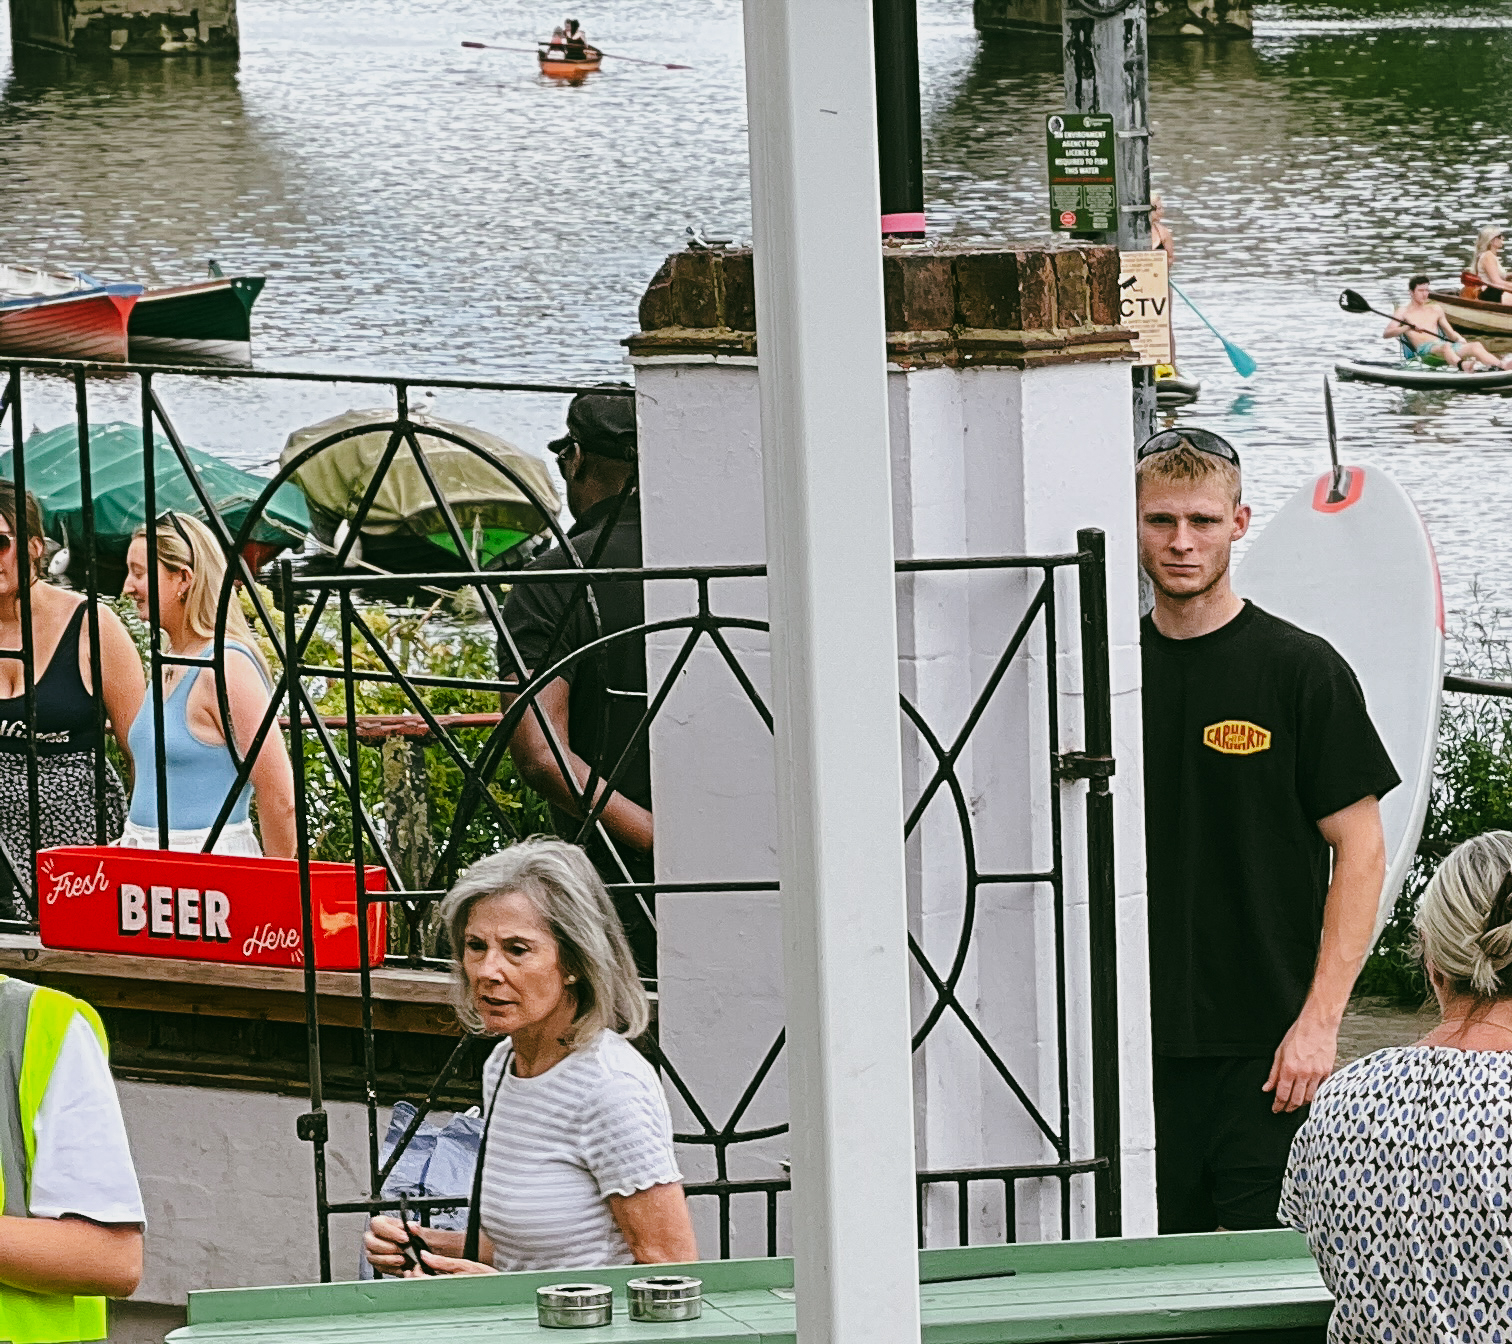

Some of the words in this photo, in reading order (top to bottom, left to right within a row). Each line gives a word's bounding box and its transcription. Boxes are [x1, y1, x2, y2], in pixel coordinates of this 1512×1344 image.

[1120, 297, 1166, 317] CTV
[46, 861, 109, 905] Fresh
[119, 883, 232, 942] BEER
[242, 922, 300, 957] Here
